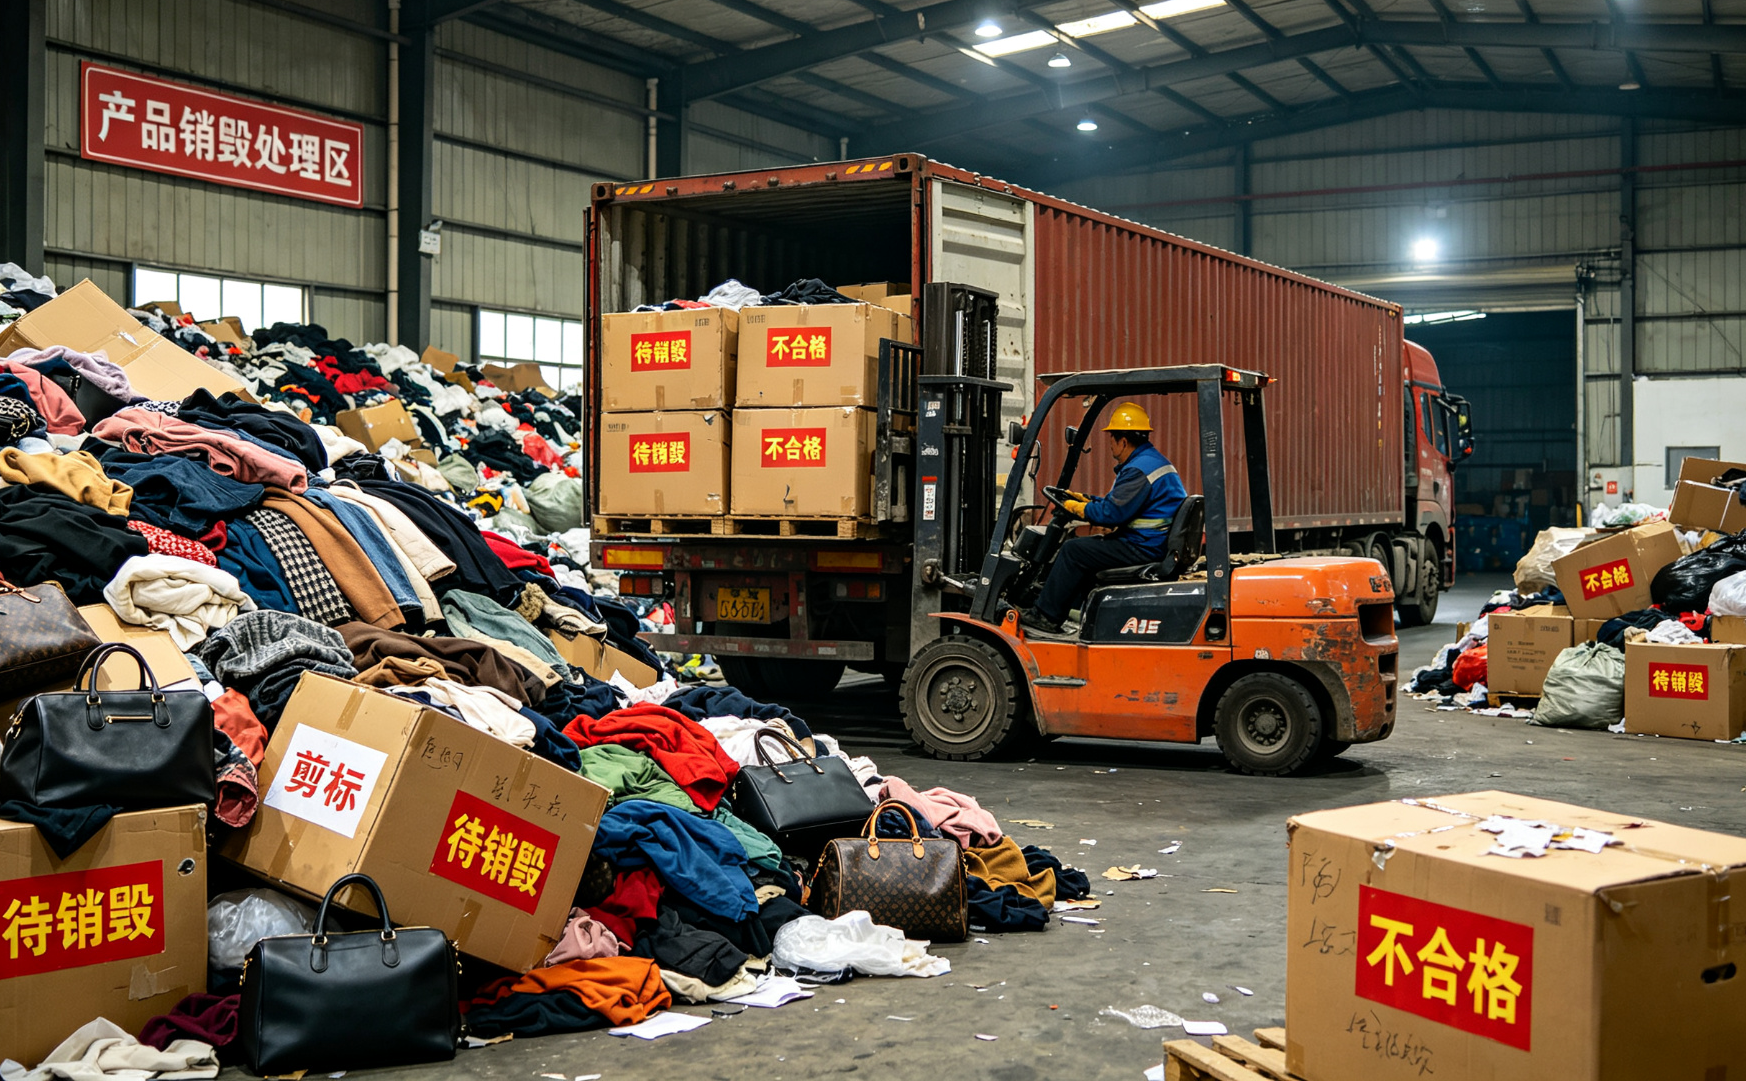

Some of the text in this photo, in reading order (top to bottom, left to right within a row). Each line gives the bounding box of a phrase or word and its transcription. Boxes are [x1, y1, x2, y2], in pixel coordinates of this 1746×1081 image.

[98, 90, 352, 187] 产品销毁处理区
[771, 335, 826, 360] 不合格
[765, 436, 822, 460] 不合格
[285, 751, 364, 811] 剪标
[448, 814, 545, 896] 待销毁
[2, 884, 154, 958] 待销毁
[1367, 915, 1522, 1023] 不合格
